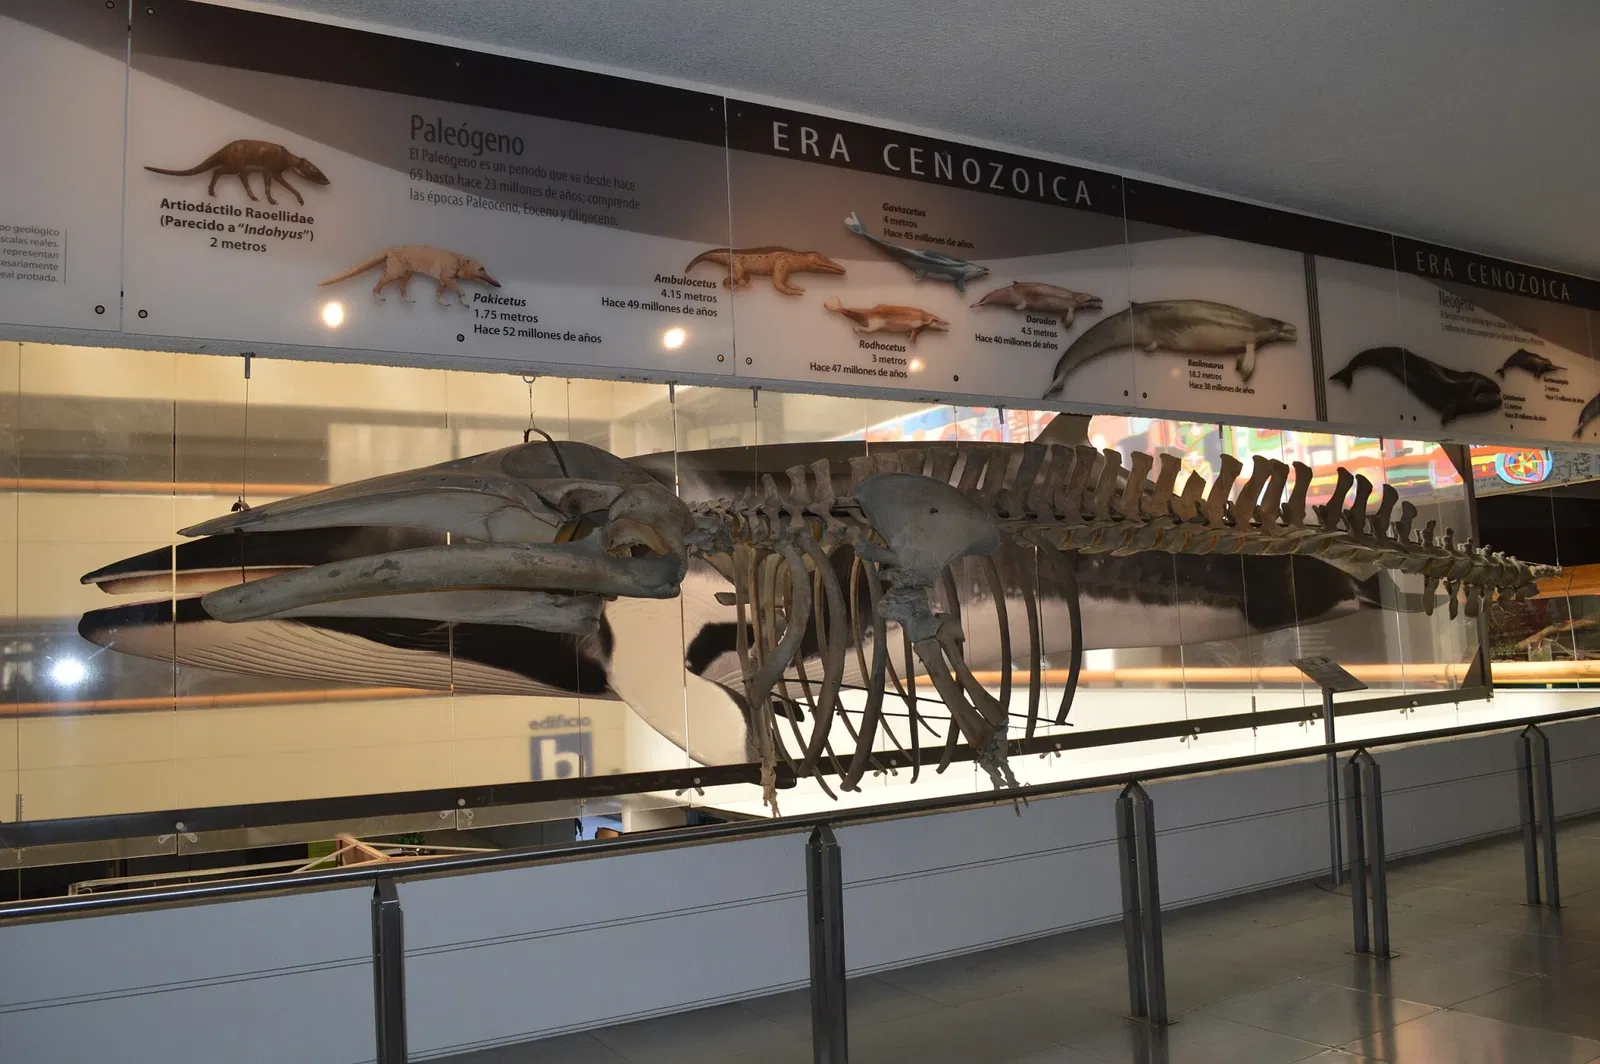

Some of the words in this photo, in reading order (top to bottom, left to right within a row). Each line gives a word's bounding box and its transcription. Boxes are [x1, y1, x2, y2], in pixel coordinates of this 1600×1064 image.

[410, 114, 525, 156] Paleógeno
[409, 148, 419, 161] El
[422, 148, 477, 169] Paleógeno
[479, 159, 491, 171] es
[493, 162, 506, 173] un
[549, 170, 568, 183] que
[570, 172, 581, 183] va
[583, 173, 612, 188] desde
[614, 177, 635, 192] hace
[773, 121, 851, 162] ERA
[883, 143, 1092, 206] CENOZOICA
[409, 168, 423, 181] 65
[425, 170, 454, 186] hasta
[457, 174, 481, 189] hace
[484, 177, 497, 191] 23
[500, 180, 543, 197] millones
[544, 185, 557, 199] de
[587, 191, 641, 210] comprende
[160, 198, 243, 218] Artiodáctilo
[245, 207, 315, 225] Raoellidae
[409, 188, 424, 202] las
[427, 188, 464, 207] épocas
[523, 202, 558, 219] Eoceno
[560, 209, 566, 221] y
[568, 207, 619, 227] Oligoceno.
[883, 203, 926, 218] Gaviacetus
[160, 215, 225, 233] (Parecido
[228, 224, 236, 233] a
[883, 217, 888, 225] 4
[890, 218, 918, 229] metros
[30, 239, 60, 248] reales.
[209, 237, 218, 248] 2
[221, 239, 267, 253] metros
[884, 228, 903, 240] Hace
[904, 231, 913, 241] 45
[915, 232, 945, 246] millones
[947, 237, 955, 248] de
[957, 238, 974, 250] años
[3, 248, 59, 260] representan
[16, 272, 59, 284] probada.
[654, 273, 717, 289] Ambulocetus
[1416, 251, 1454, 279] ERA
[1468, 262, 1571, 301] CENOZOICA
[473, 292, 527, 308] Pakicetus
[661, 288, 682, 300] 4.15
[684, 292, 717, 304] metros
[601, 296, 626, 309] Hace
[627, 299, 640, 310] 49
[641, 300, 681, 315] millones
[682, 304, 695, 316] de
[697, 305, 718, 317] años
[474, 308, 497, 320] 1.75
[500, 311, 538, 324] metros
[1026, 314, 1057, 326] Dorudon
[474, 324, 501, 336] Hace
[502, 326, 516, 337] 52
[518, 327, 561, 341] millones
[563, 331, 576, 342] de
[578, 332, 602, 344] años
[1021, 326, 1031, 335] 4.5
[1033, 328, 1058, 338] metros
[859, 339, 906, 353] Rodhocetus
[975, 333, 992, 343] Hace
[993, 335, 1002, 344] 40
[1004, 336, 1032, 347] millones
[1033, 339, 1041, 348] de
[1042, 340, 1058, 350] años
[872, 354, 877, 363] 3
[878, 355, 907, 366] metros
[1188, 359, 1224, 370] Basilosaurus
[810, 362, 831, 373] Hace
[832, 364, 842, 374] 47
[843, 365, 877, 377] millones
[878, 367, 887, 378] de
[888, 369, 908, 379] años
[1202, 372, 1222, 380] metros
[1189, 381, 1203, 390] Hace
[1212, 383, 1234, 392] millones
[1235, 385, 1242, 393] de
[541, 739, 586, 781] b
